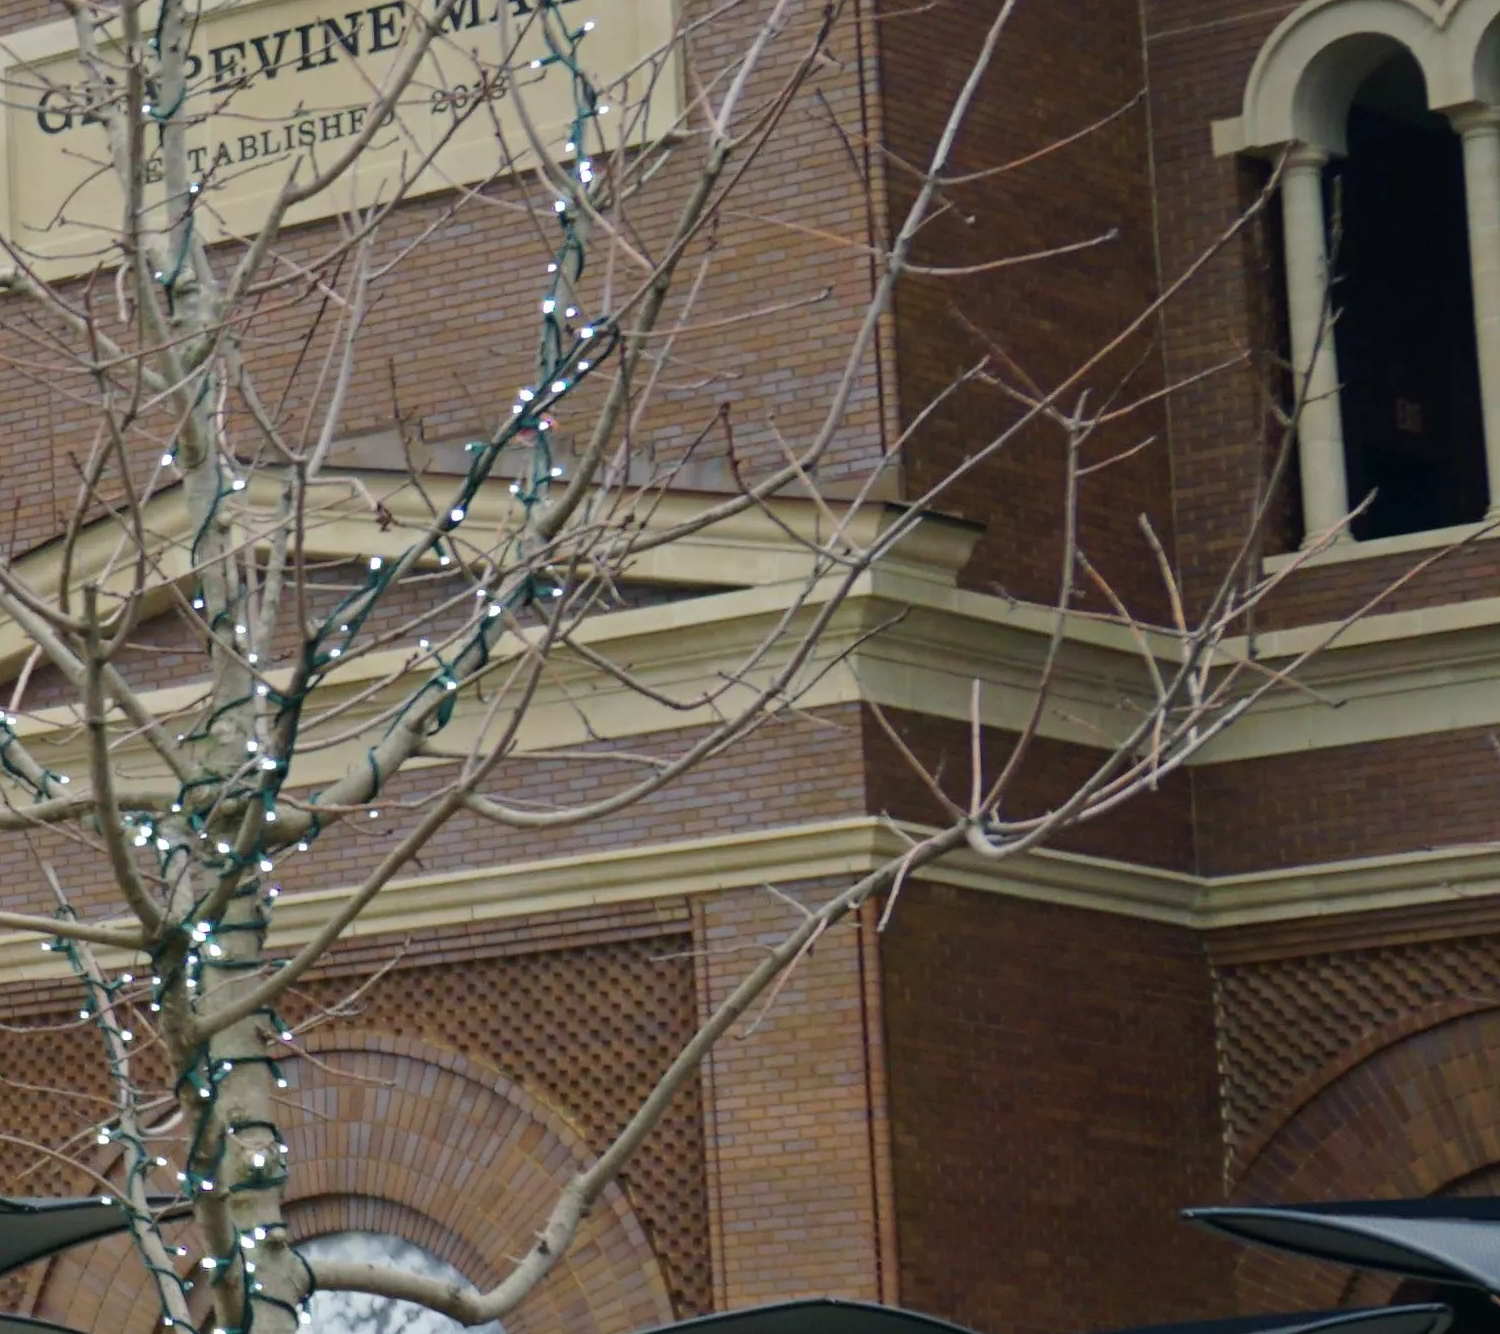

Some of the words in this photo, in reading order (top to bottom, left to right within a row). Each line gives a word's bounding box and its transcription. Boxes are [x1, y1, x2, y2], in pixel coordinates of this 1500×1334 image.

[37, 0, 407, 134] GEVINE
[142, 103, 395, 185] ETABLISHE
[431, 76, 507, 115] 208
